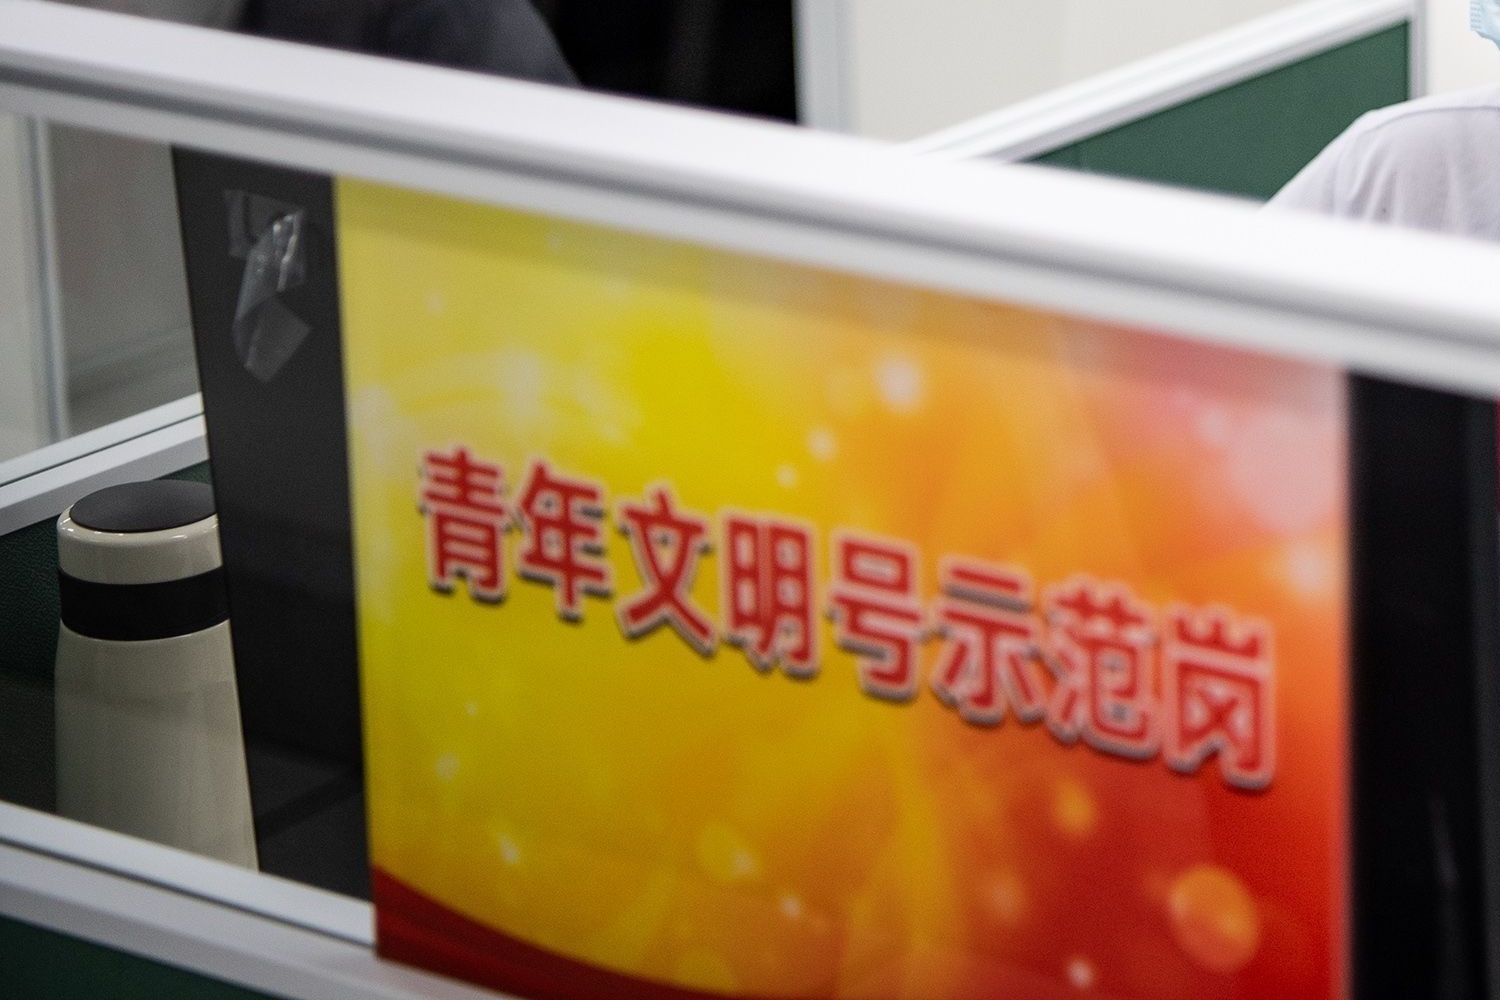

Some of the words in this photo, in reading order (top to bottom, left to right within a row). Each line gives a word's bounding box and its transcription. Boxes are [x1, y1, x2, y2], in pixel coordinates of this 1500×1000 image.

[419, 447, 1275, 786] 青年文明号示范岗
